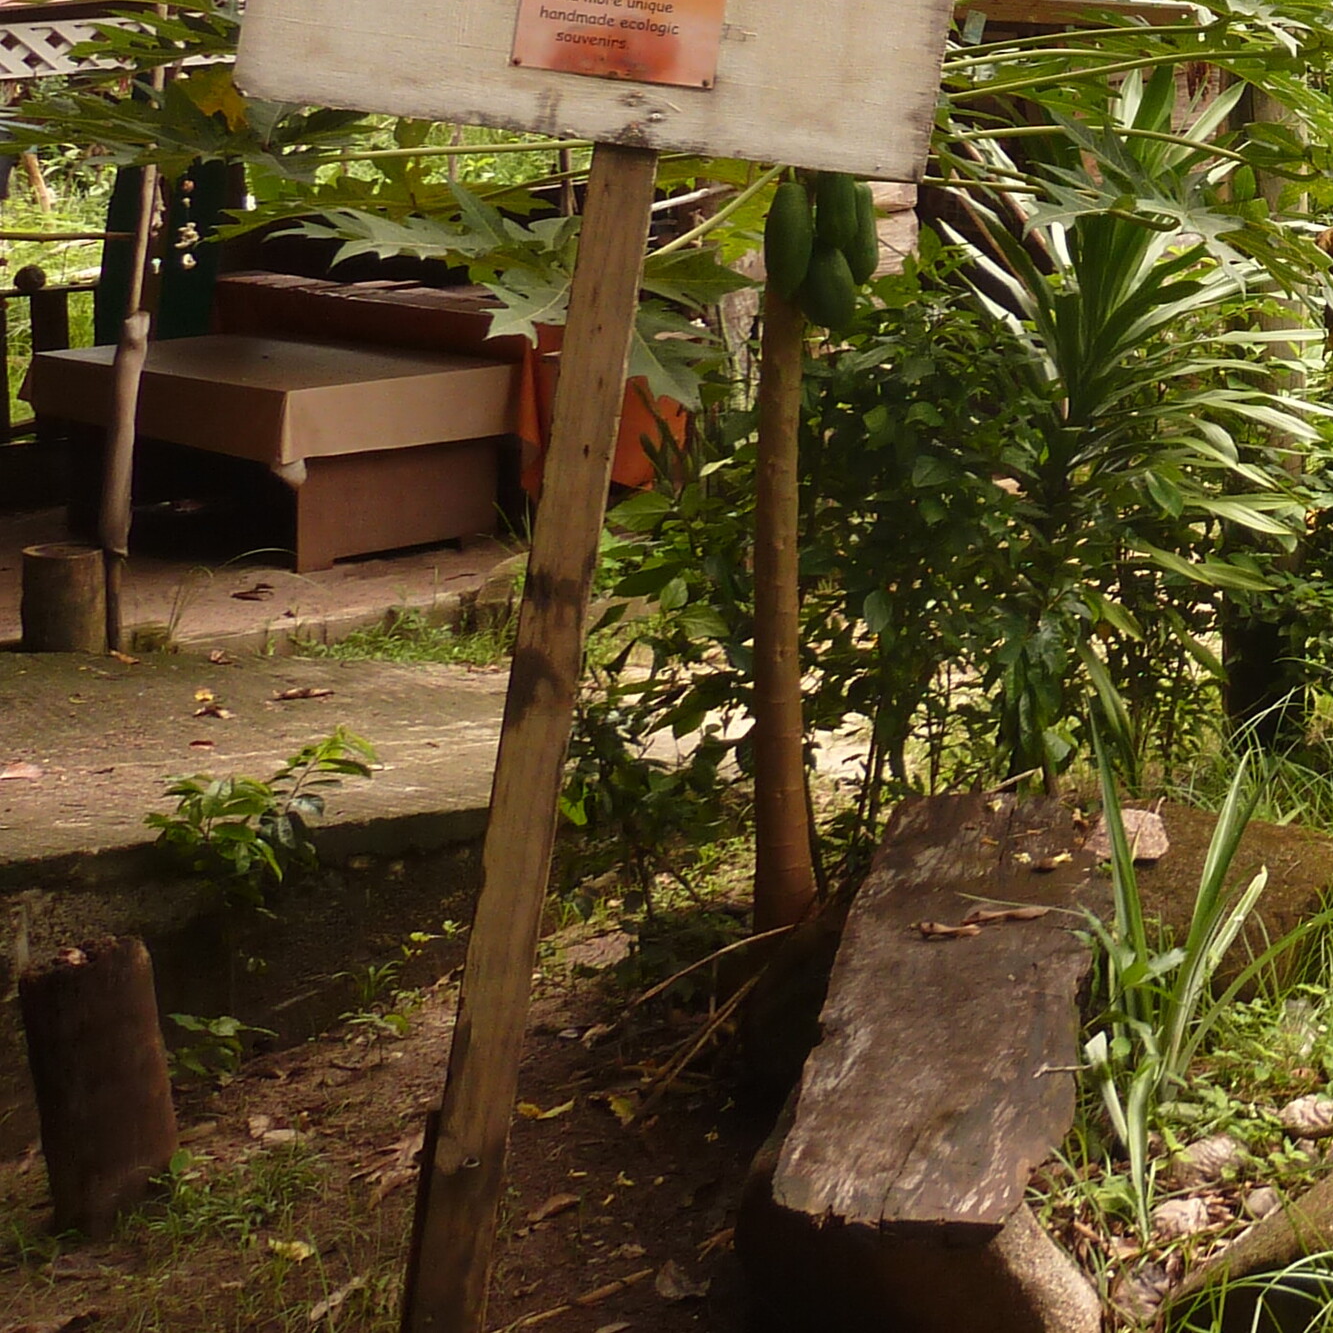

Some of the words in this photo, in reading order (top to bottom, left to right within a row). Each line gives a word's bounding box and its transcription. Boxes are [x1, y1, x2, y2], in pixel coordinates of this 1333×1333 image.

[627, 0, 674, 15] unique
[539, 6, 615, 27] handmade
[620, 18, 680, 37] ecologic
